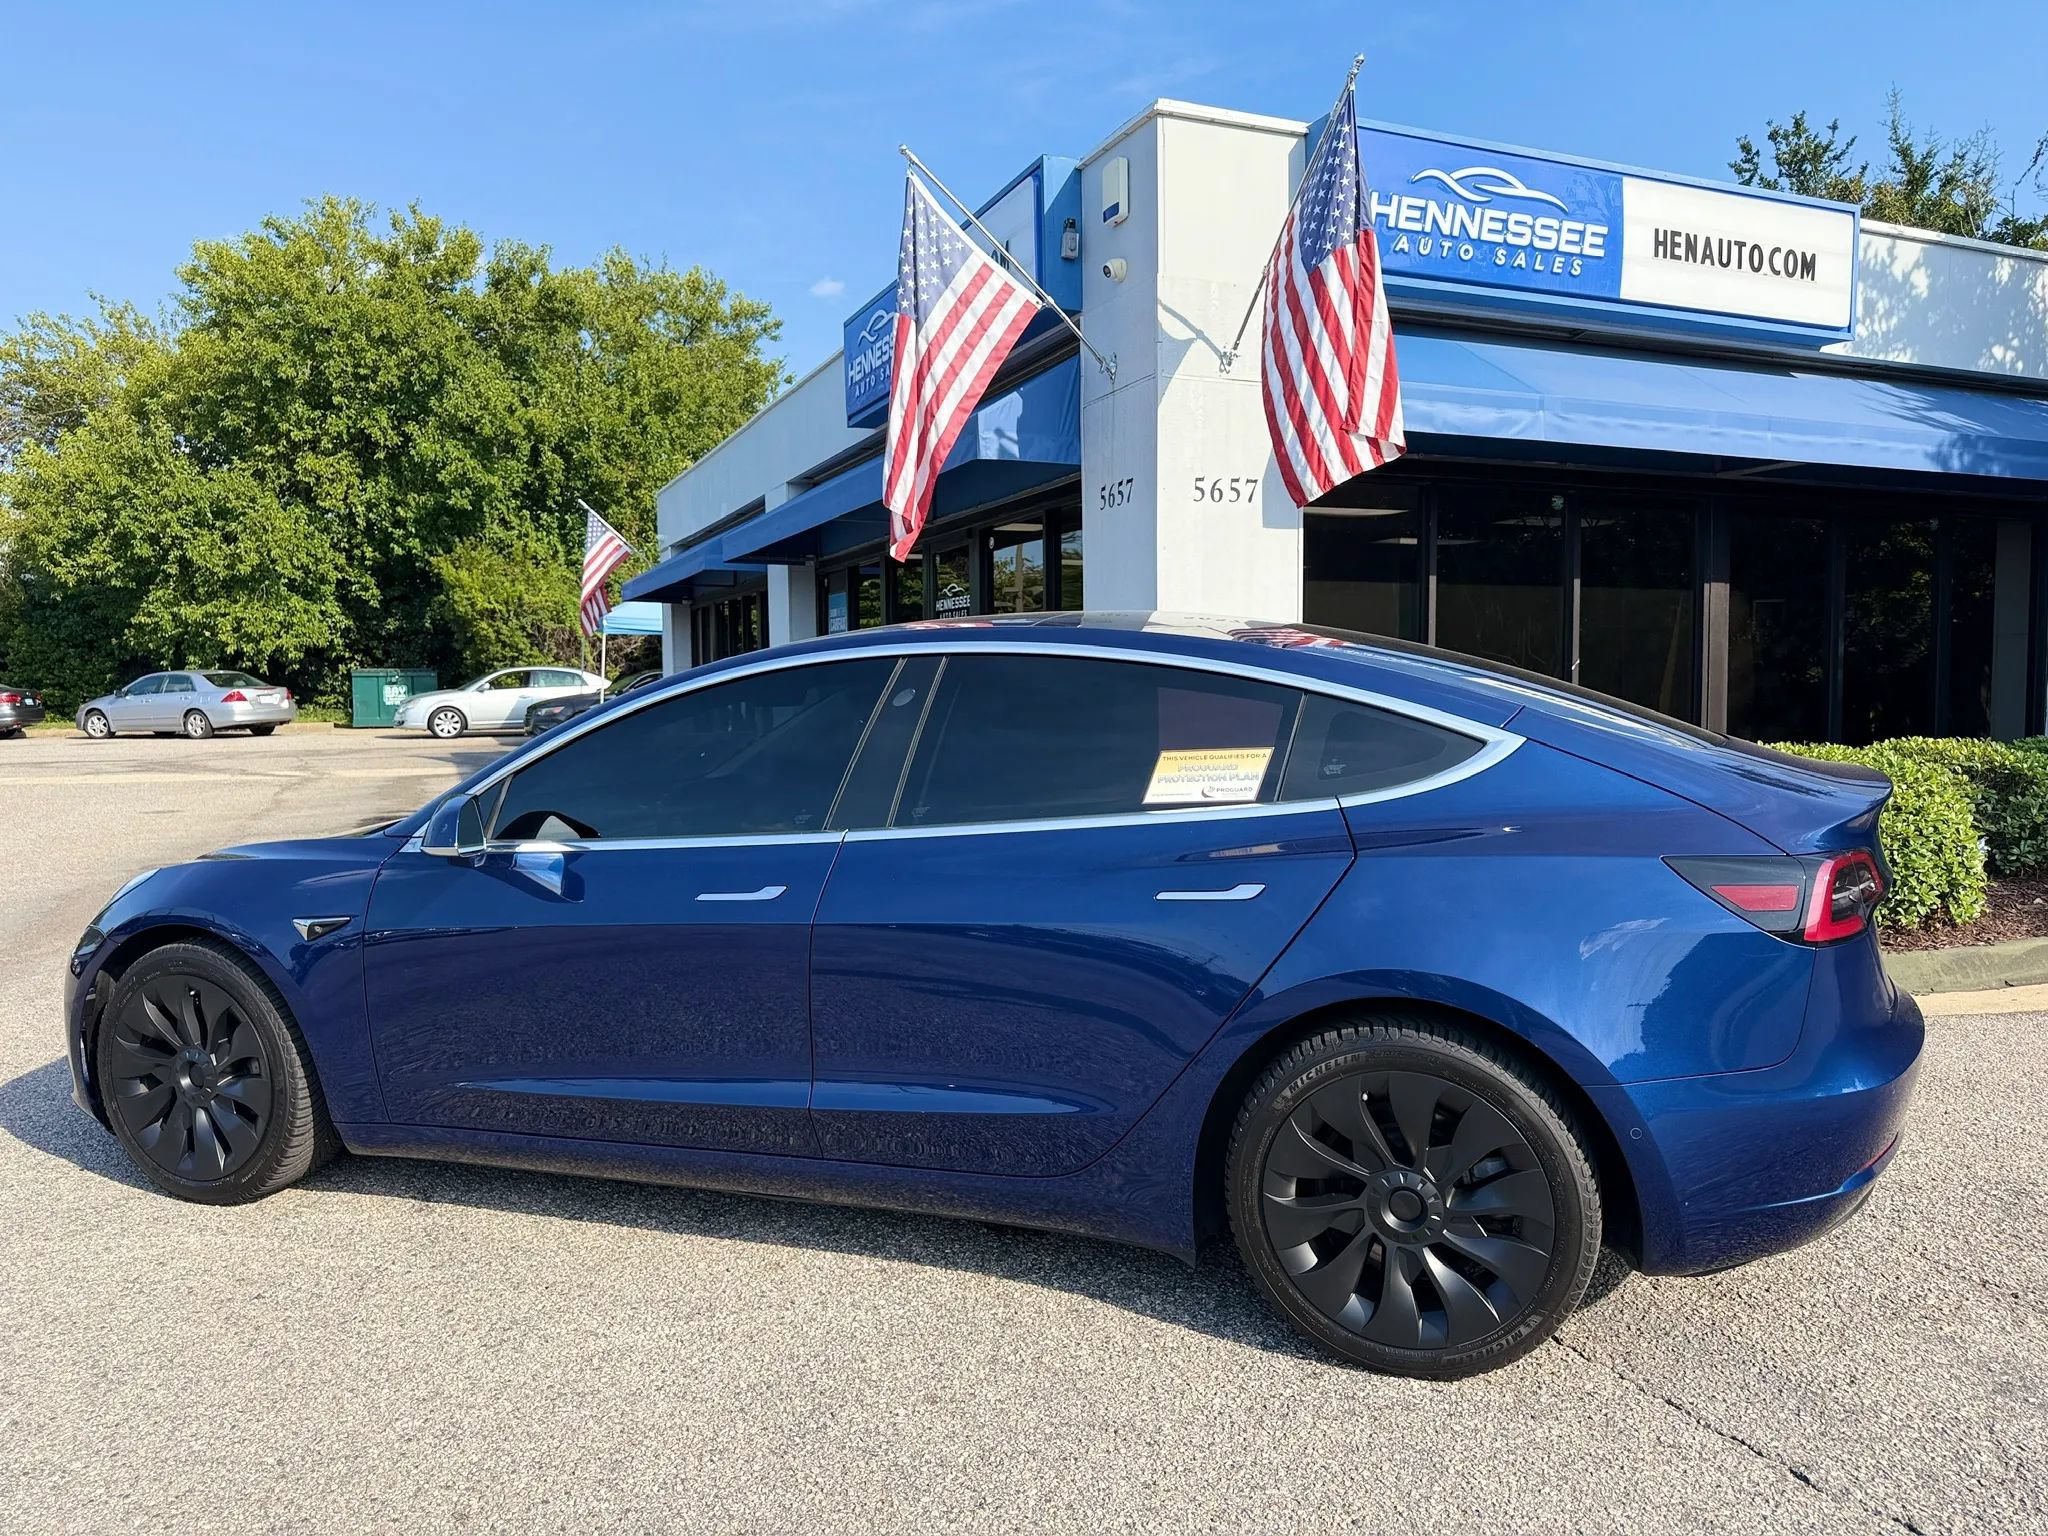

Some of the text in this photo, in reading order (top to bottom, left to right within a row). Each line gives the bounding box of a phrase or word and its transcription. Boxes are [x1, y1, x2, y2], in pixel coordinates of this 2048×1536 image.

[1370, 191, 1609, 258] HENNESSEE
[1394, 234, 1584, 276] AUTO SALES
[855, 375, 876, 398] AUTO
[1099, 477, 1134, 511] 5657
[1193, 475, 1259, 504] 5657
[935, 594, 971, 612] HENNESSEE
[1157, 771, 1261, 784] PROTECTION PLAN
[1288, 1053, 1361, 1096] MICHELIN
